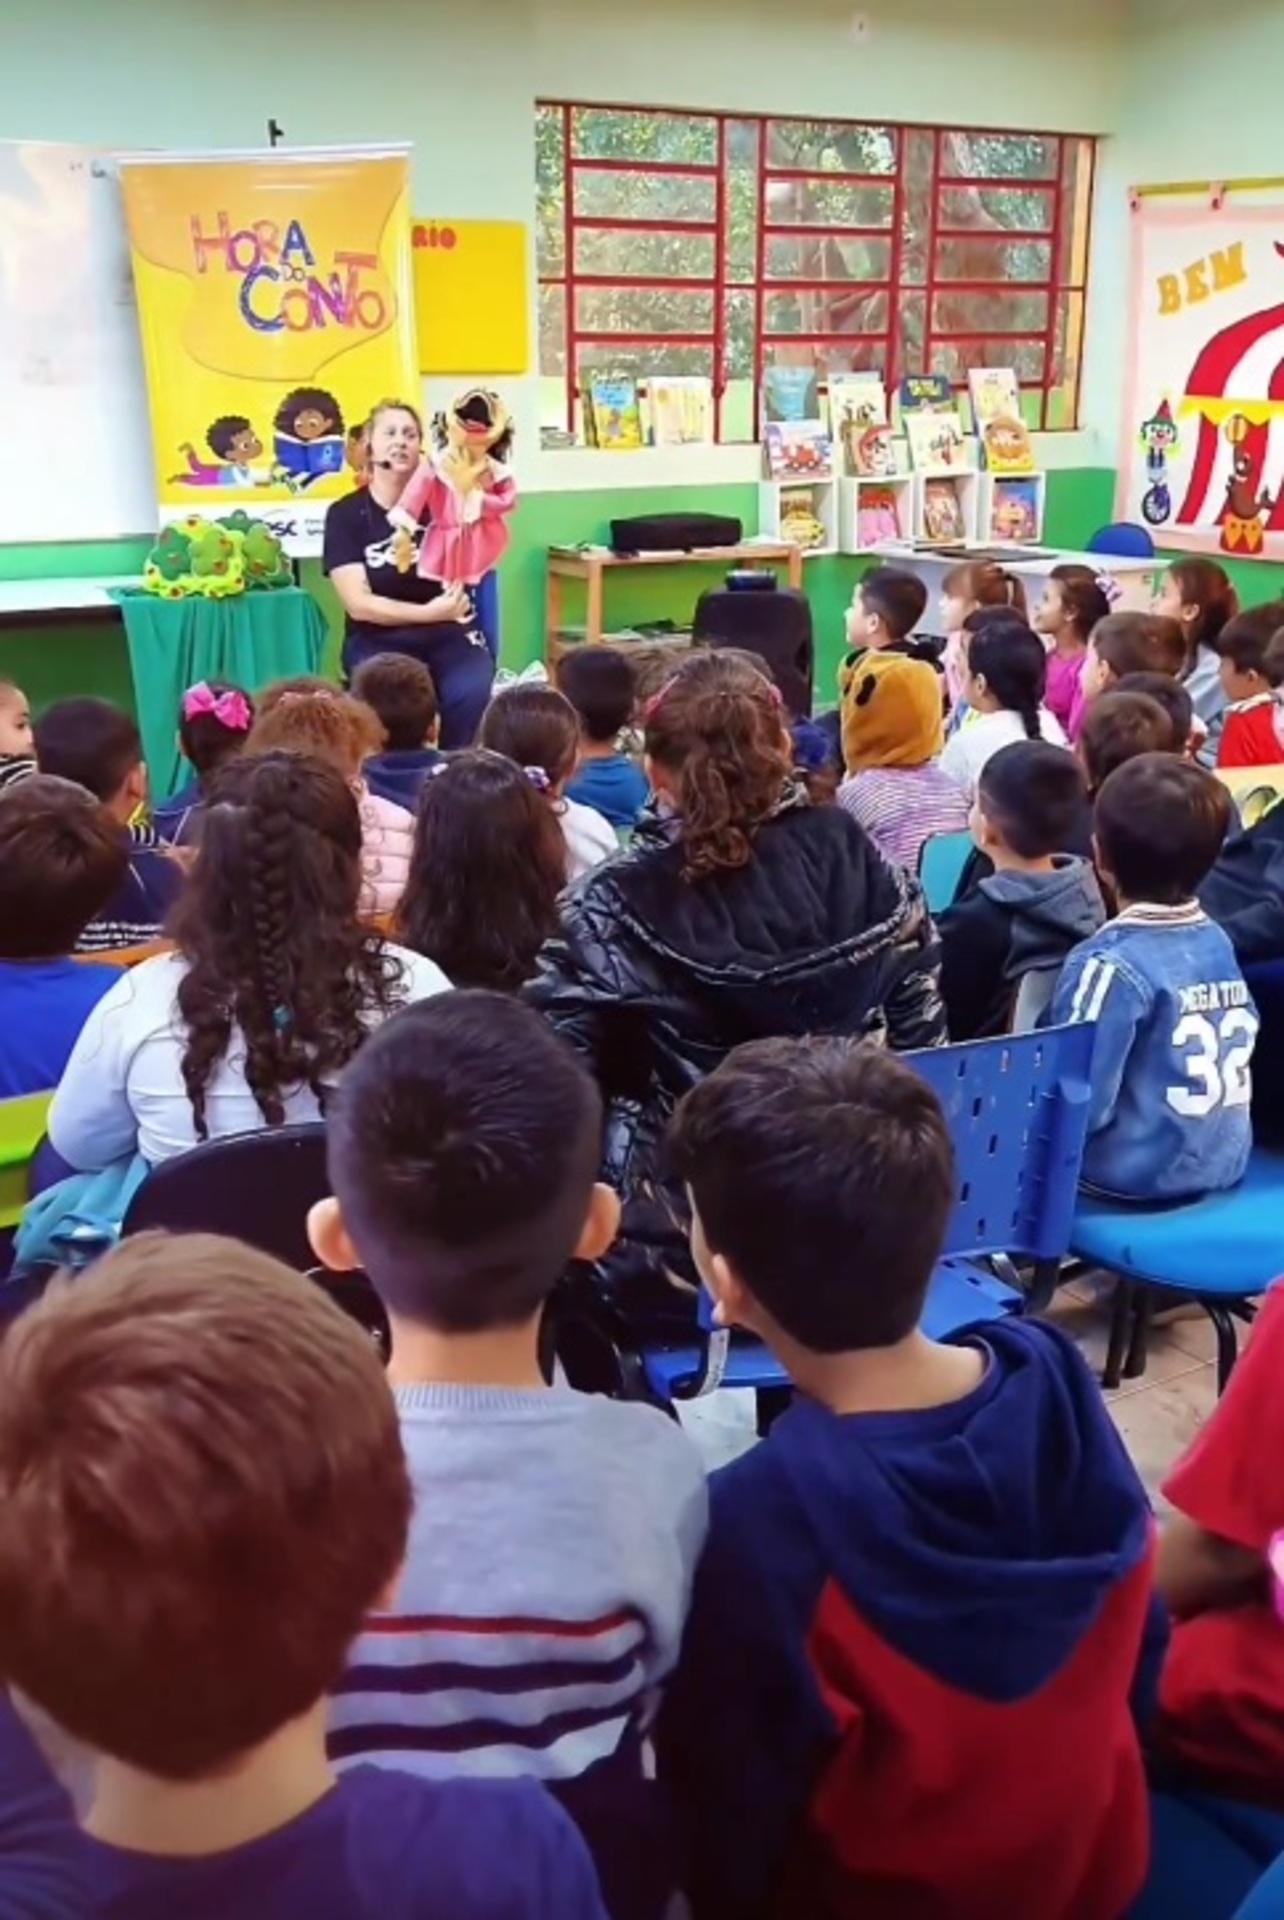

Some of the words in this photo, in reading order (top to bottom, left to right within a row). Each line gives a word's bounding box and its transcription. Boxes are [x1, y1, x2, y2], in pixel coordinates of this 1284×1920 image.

[190, 211, 316, 274] HORA
[1157, 241, 1247, 315] BEM
[239, 251, 386, 332] CONTO
[1166, 1008, 1260, 1115] 32
